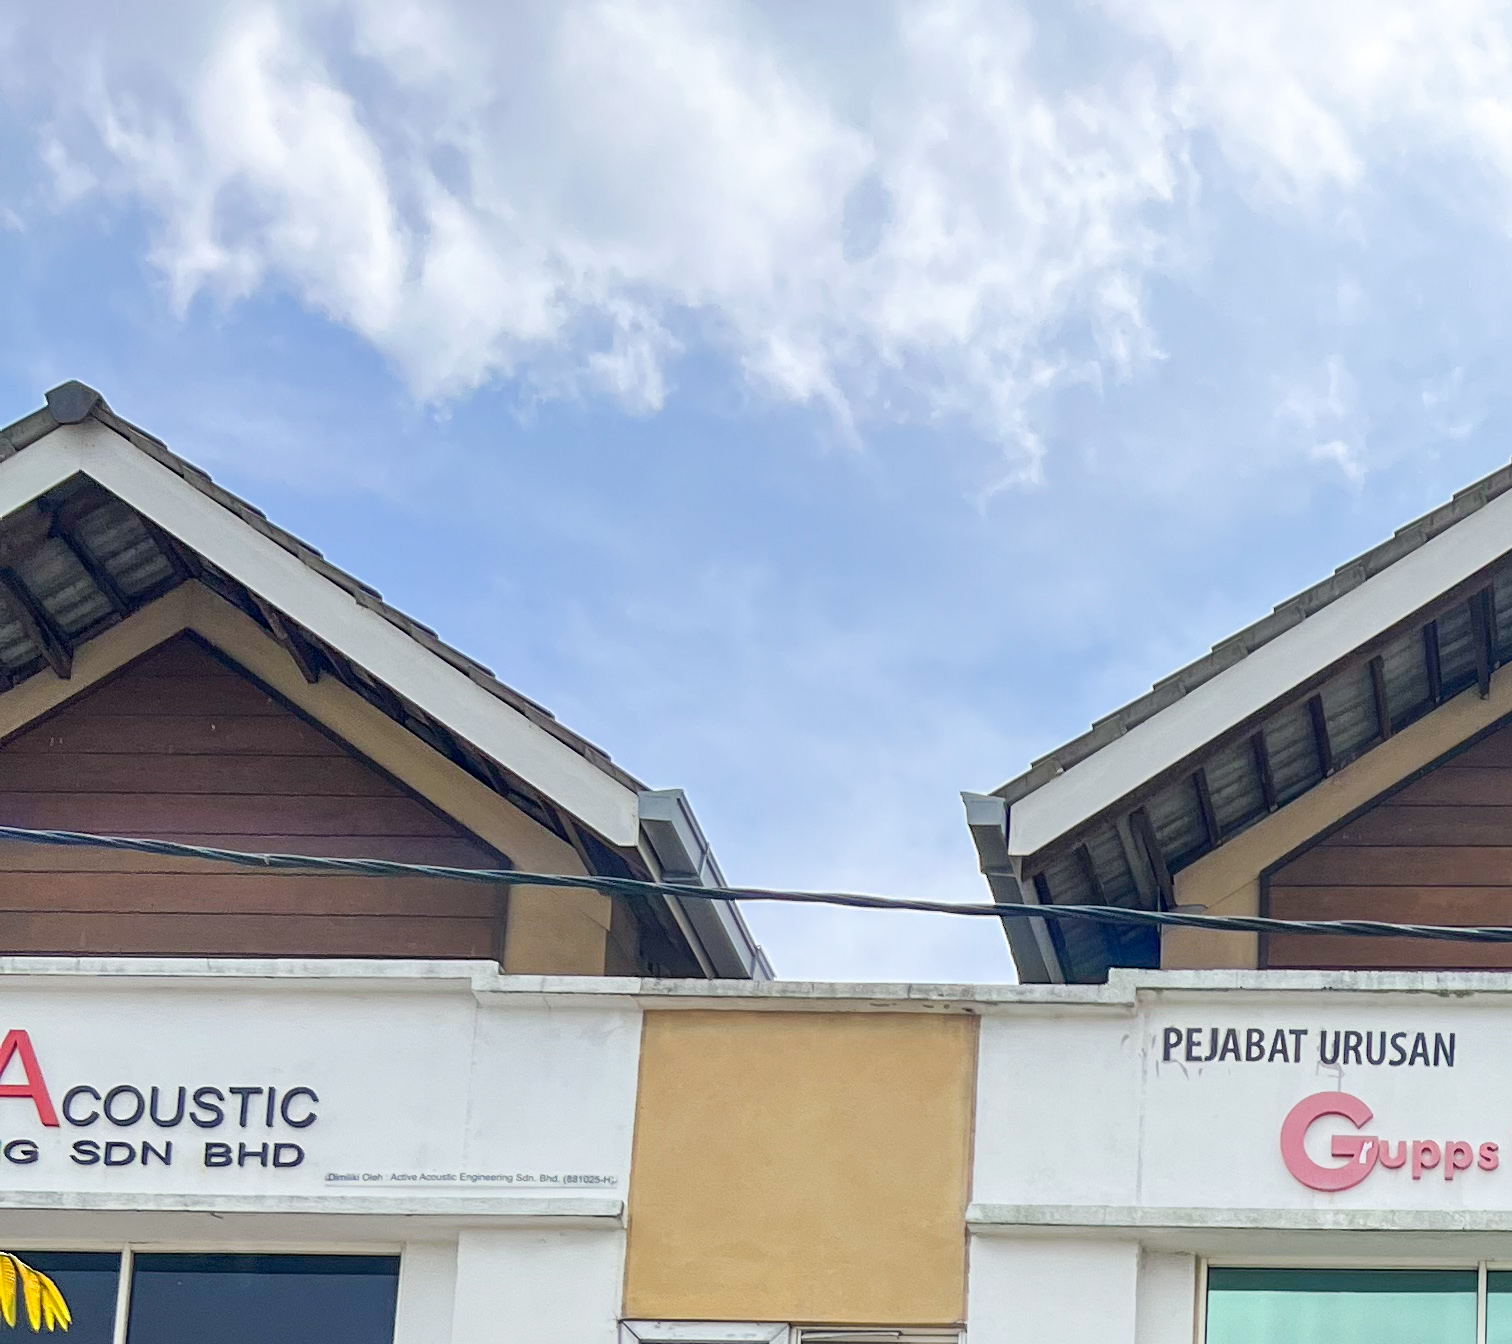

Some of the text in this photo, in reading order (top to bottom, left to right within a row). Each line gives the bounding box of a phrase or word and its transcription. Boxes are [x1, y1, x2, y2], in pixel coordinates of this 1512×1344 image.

[1162, 1026, 1456, 1068] PEJABAT URUSAN
[69, 1139, 173, 1166] SDN
[204, 1141, 305, 1168] BHD
[1279, 1090, 1500, 1192] Grupps
[390, 1172, 418, 1182] Active
[419, 1172, 457, 1182] Acoustic
[459, 1172, 514, 1184] Engineering
